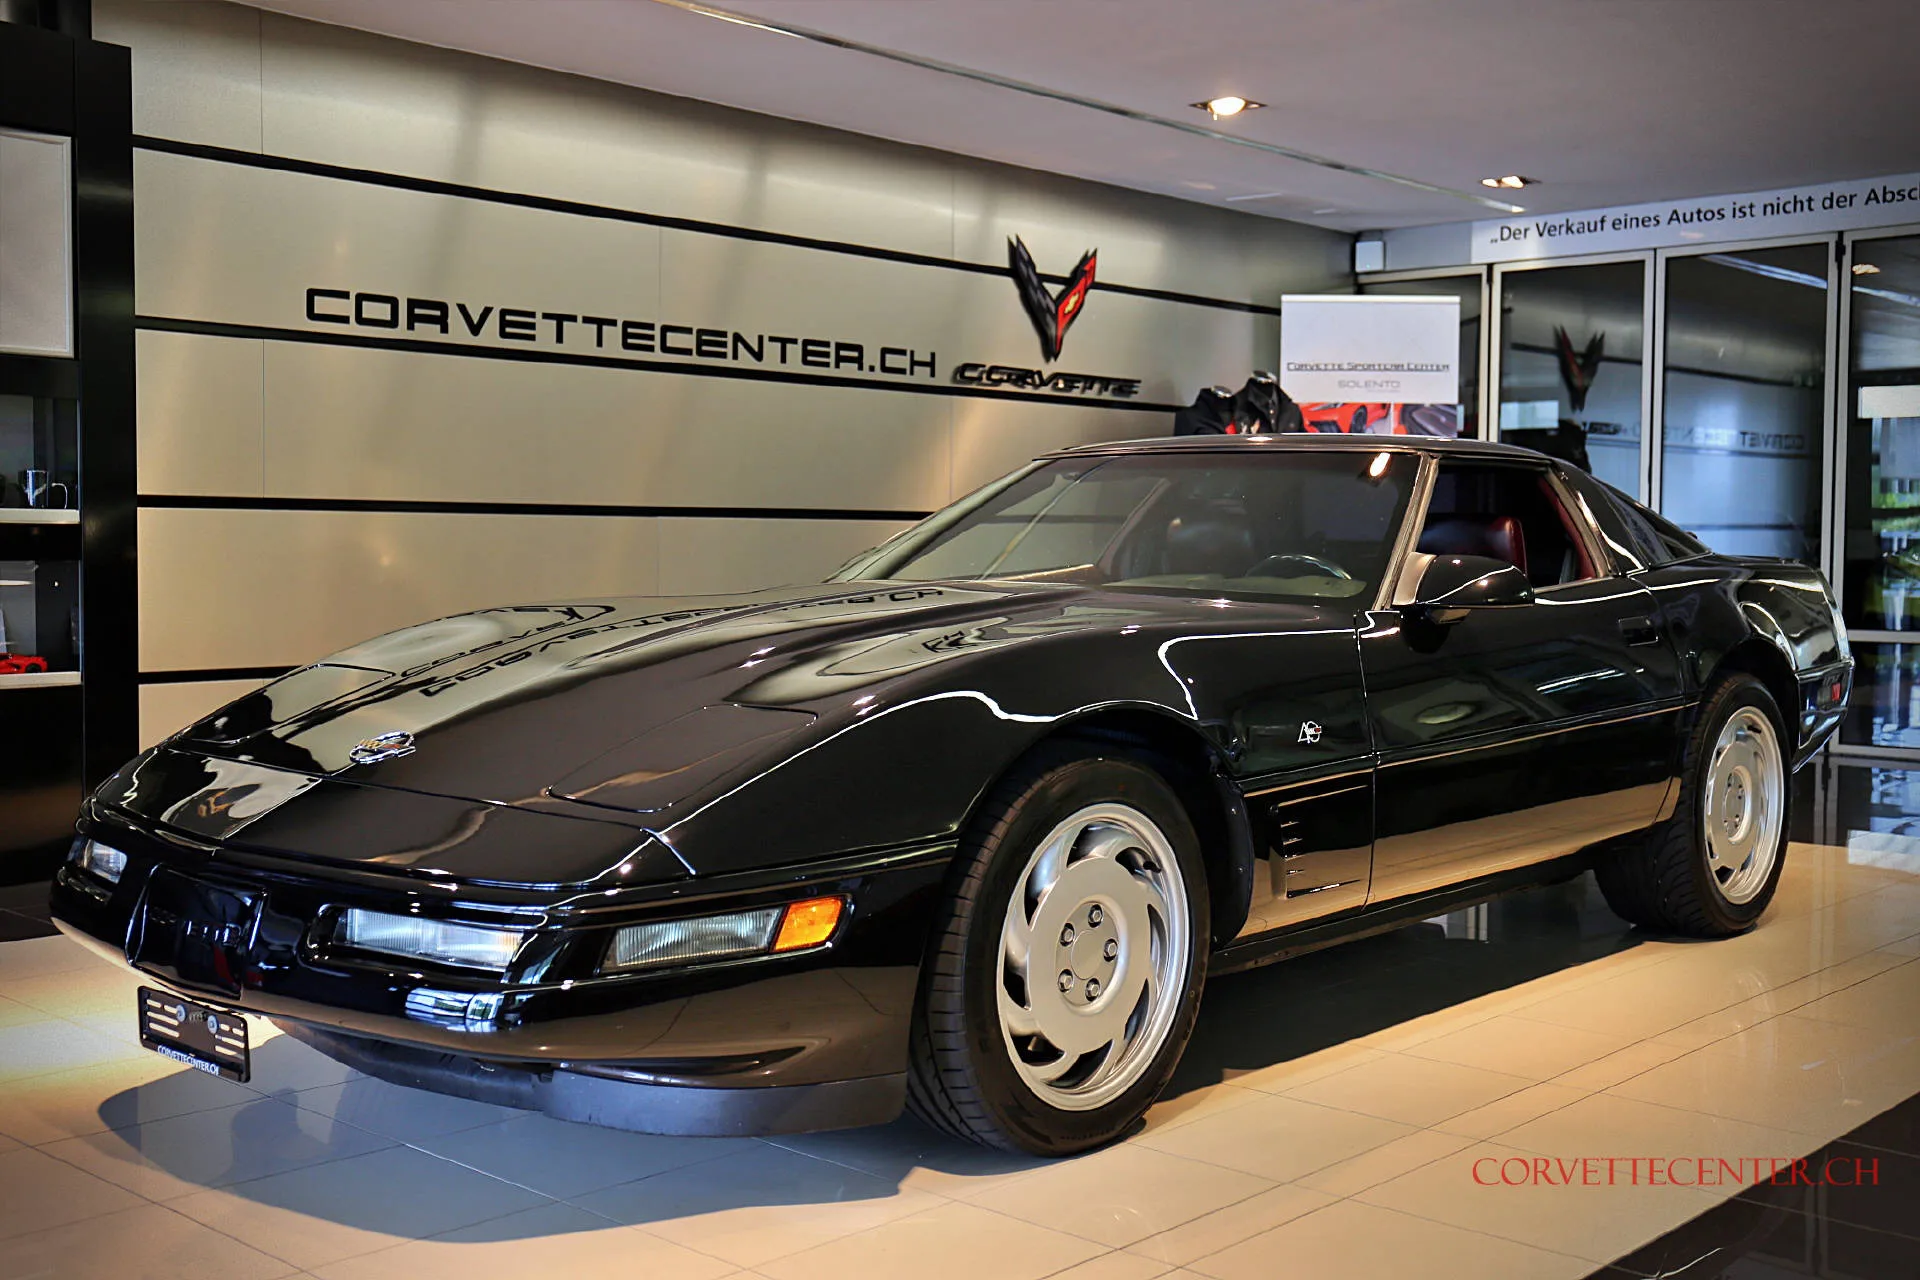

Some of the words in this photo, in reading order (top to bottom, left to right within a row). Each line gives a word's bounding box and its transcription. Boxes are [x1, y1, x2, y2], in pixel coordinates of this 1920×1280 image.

[1535, 215, 1607, 238] Verkauf
[1611, 213, 1660, 231] eines
[1667, 208, 1725, 226] Autos
[1732, 201, 1756, 219] ist
[1762, 194, 1814, 217] nicht
[1821, 191, 1857, 210] der
[1863, 181, 1920, 206] Absc
[305, 287, 936, 378] CORVETTECENTER.CH
